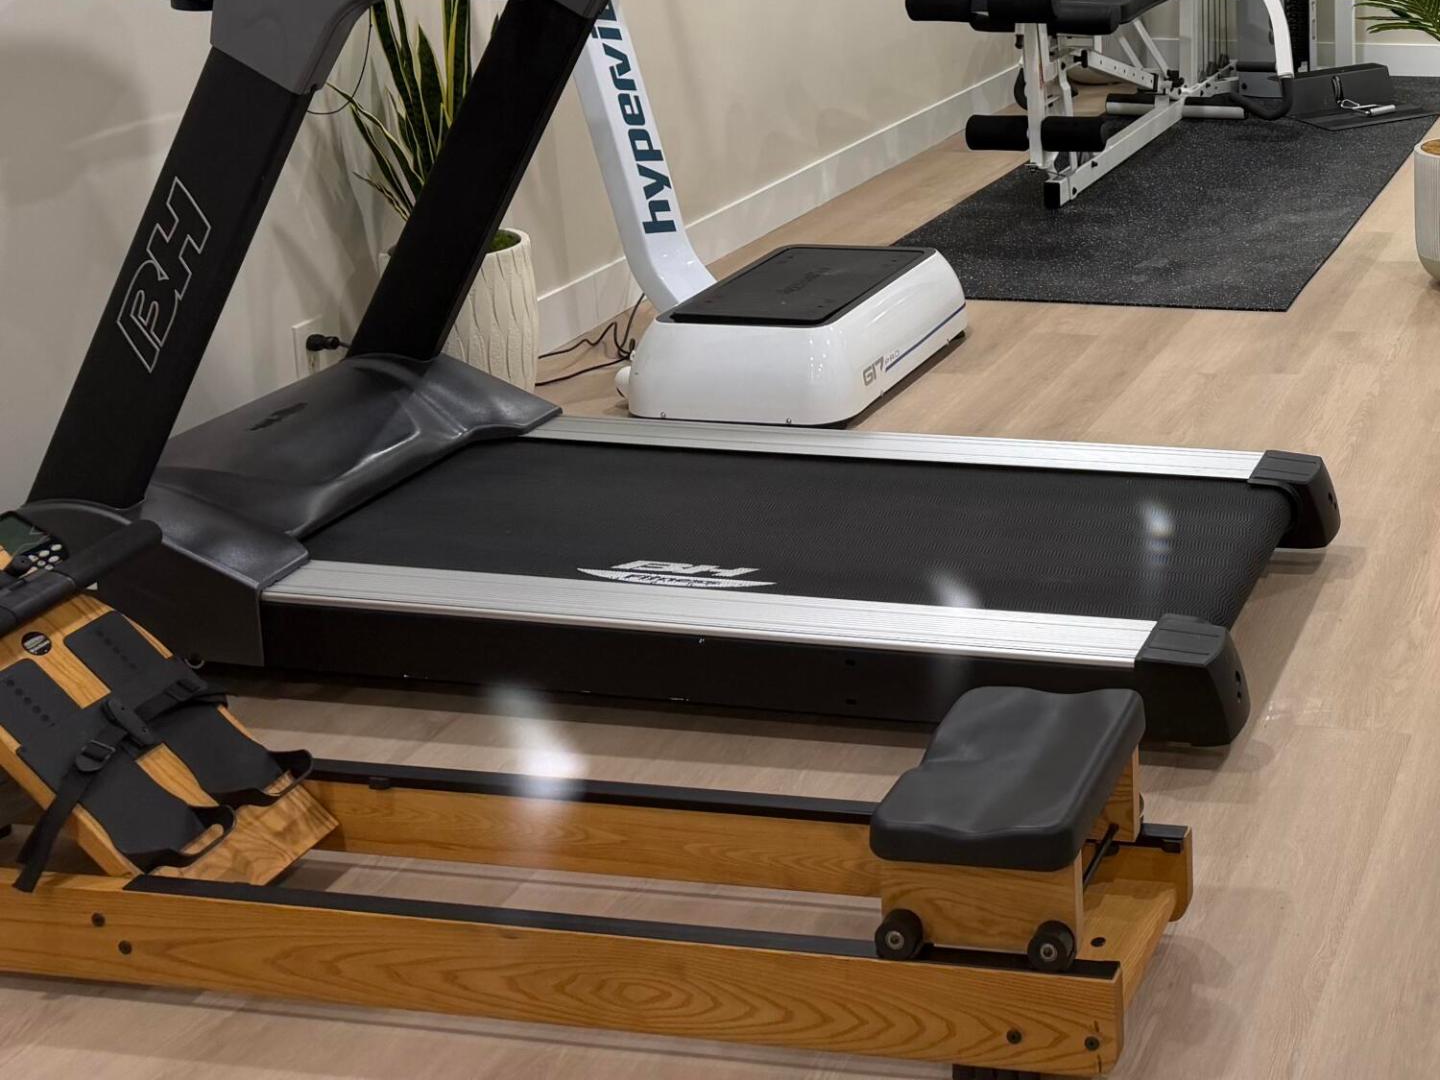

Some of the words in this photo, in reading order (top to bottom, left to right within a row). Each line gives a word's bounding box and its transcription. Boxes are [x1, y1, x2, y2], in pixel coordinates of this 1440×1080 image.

[117, 177, 212, 375] BH
[862, 355, 885, 387] G17
[611, 559, 760, 577] BH
